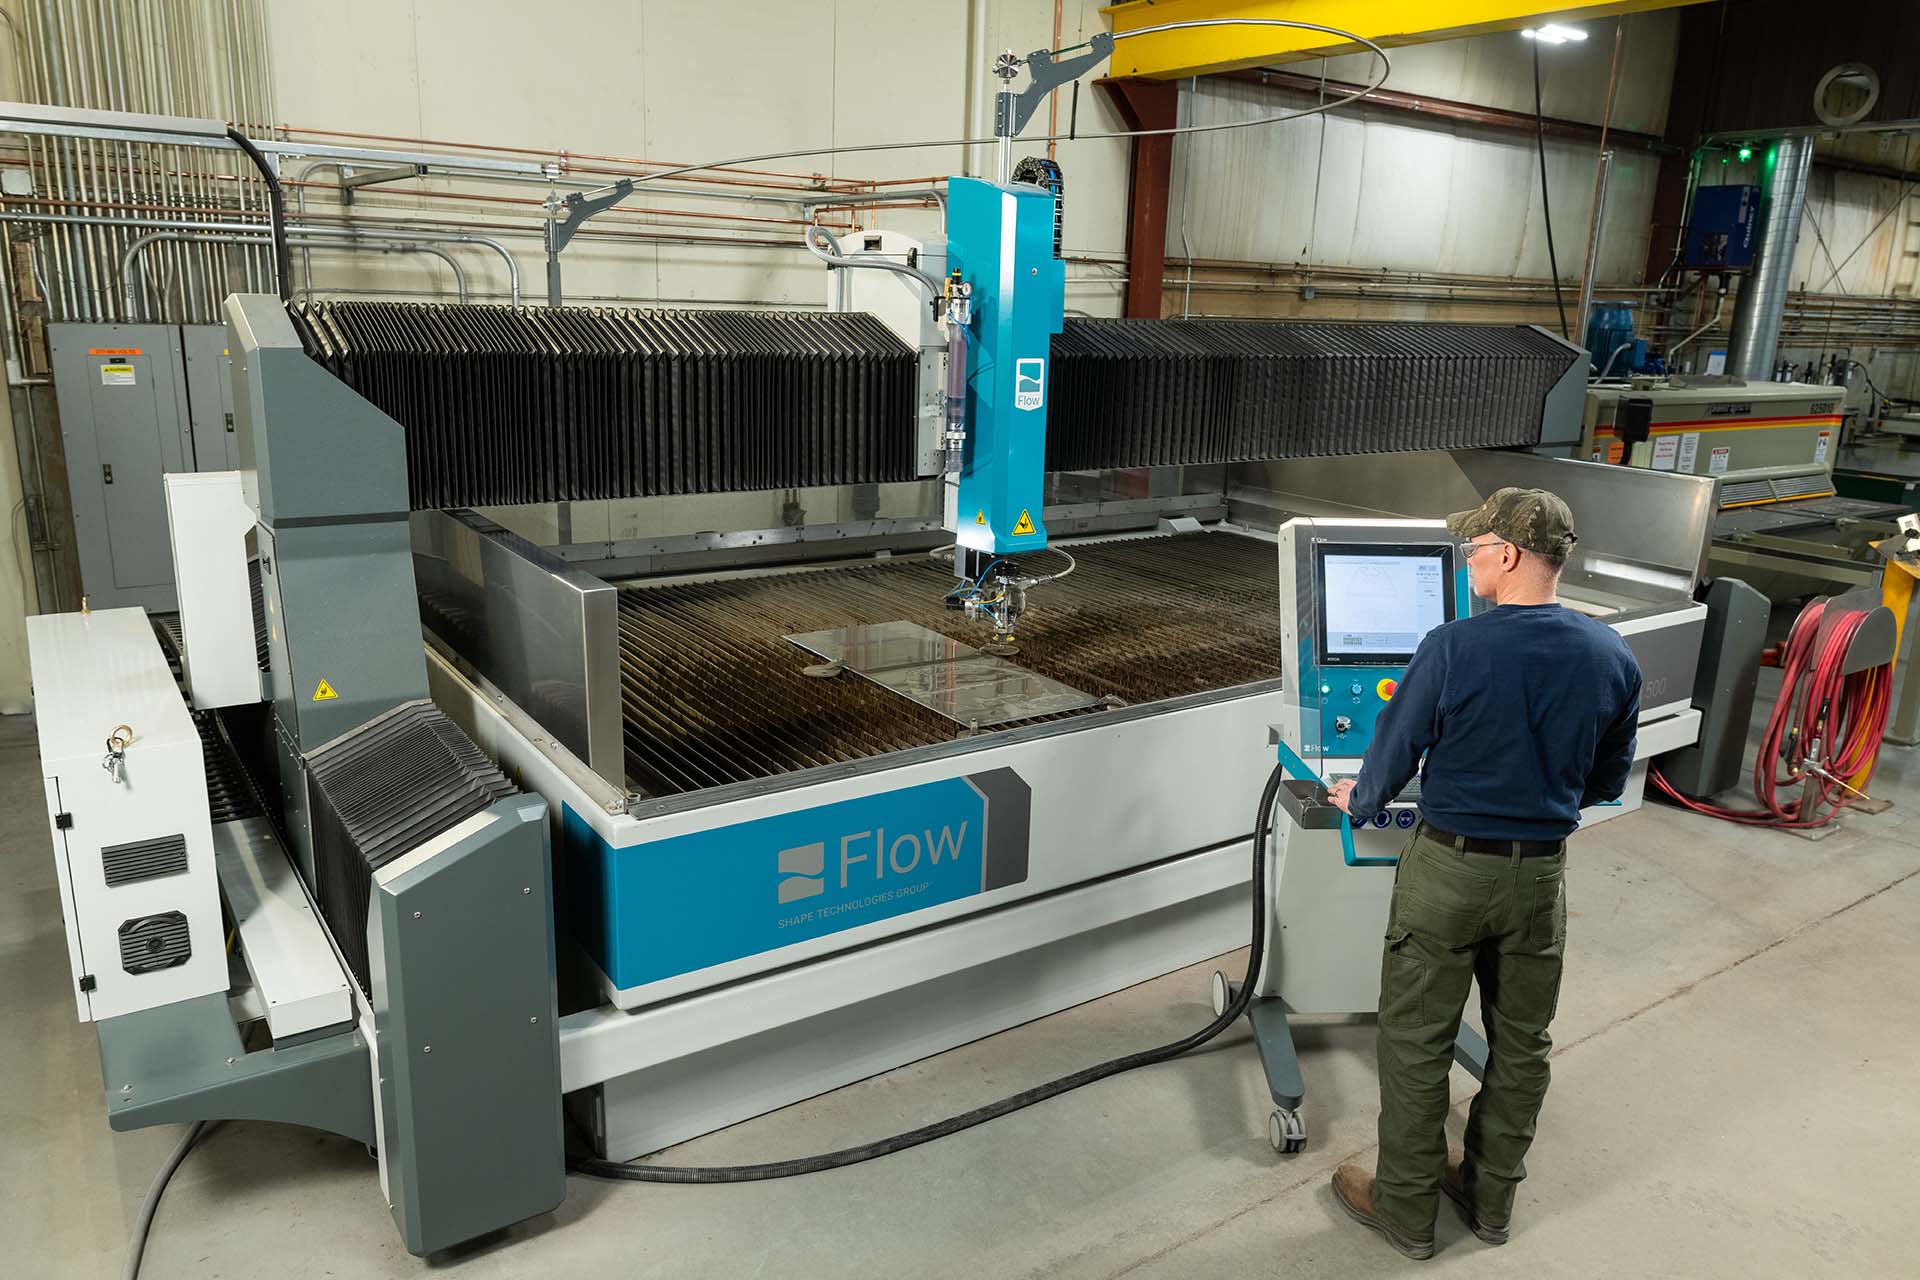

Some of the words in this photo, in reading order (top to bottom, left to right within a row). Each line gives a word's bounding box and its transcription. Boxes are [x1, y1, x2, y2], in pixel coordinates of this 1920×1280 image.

[1743, 205, 1754, 249] Quincy
[1017, 395, 1041, 406] Flow
[1310, 743, 1330, 752] Flow
[840, 820, 968, 888] Flow
[777, 911, 814, 929] SHAPE
[817, 891, 894, 919] TECHNOLOGIES
